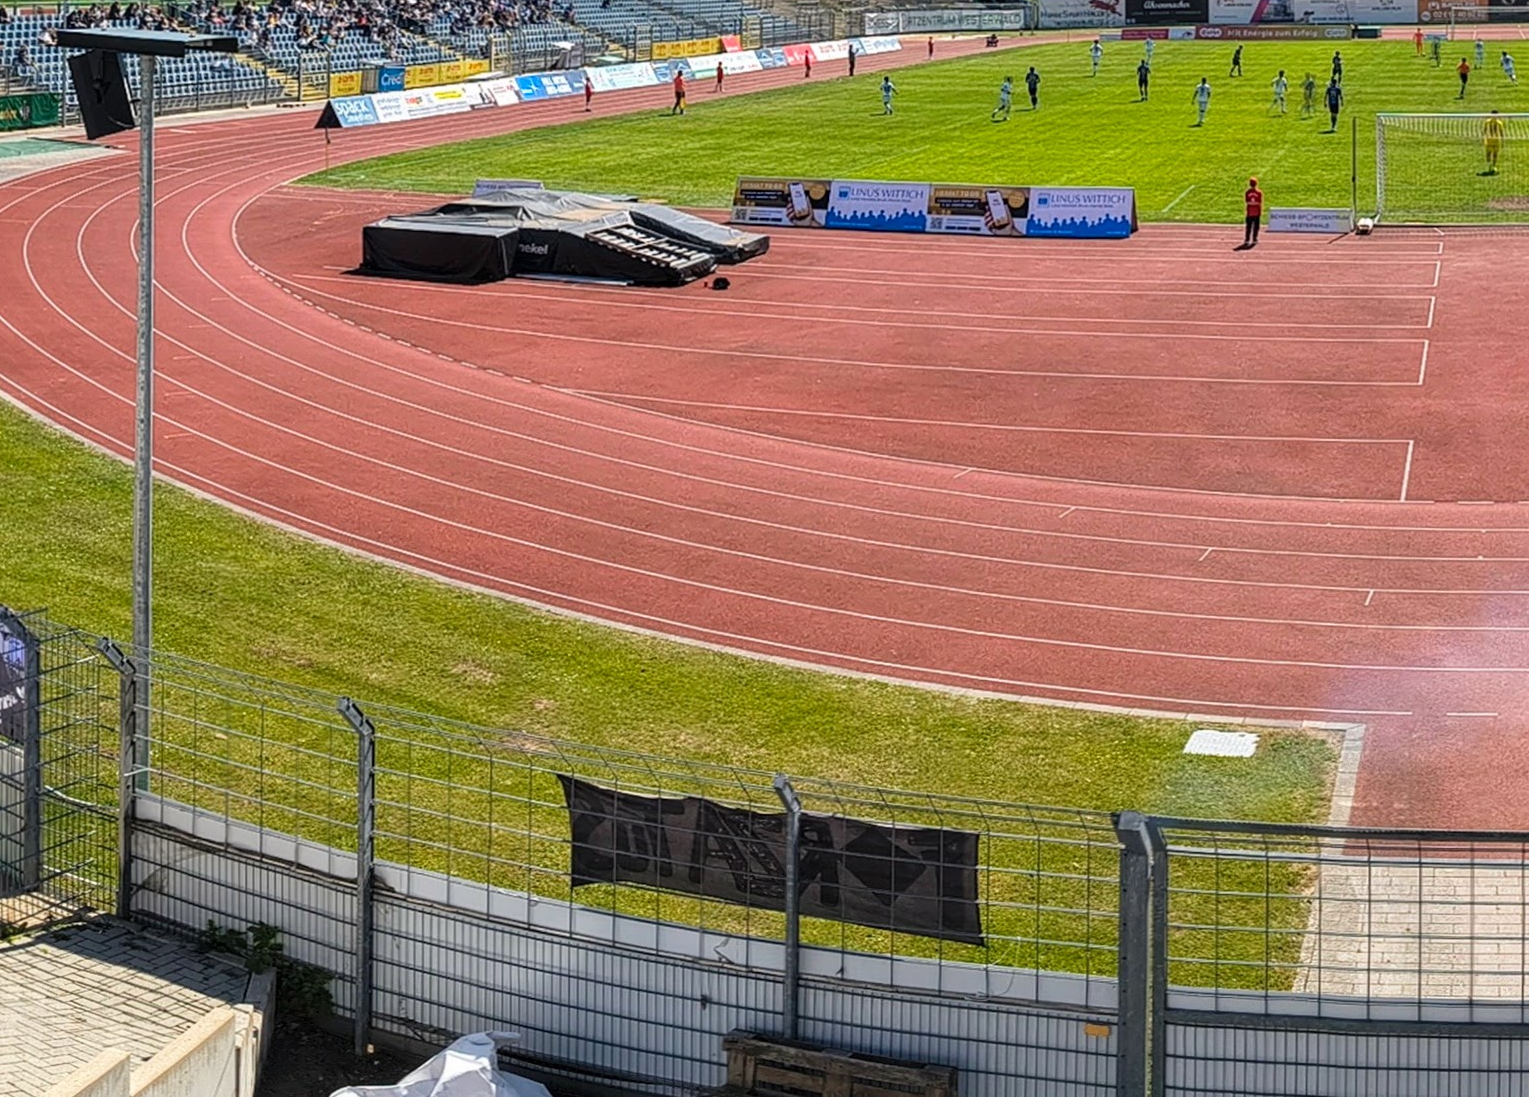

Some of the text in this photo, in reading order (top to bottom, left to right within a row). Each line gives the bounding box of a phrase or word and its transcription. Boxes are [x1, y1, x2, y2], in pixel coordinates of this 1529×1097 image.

[850, 187, 924, 199] LINUS WITTICH
[1051, 193, 1127, 204] LINUS WITTICH
